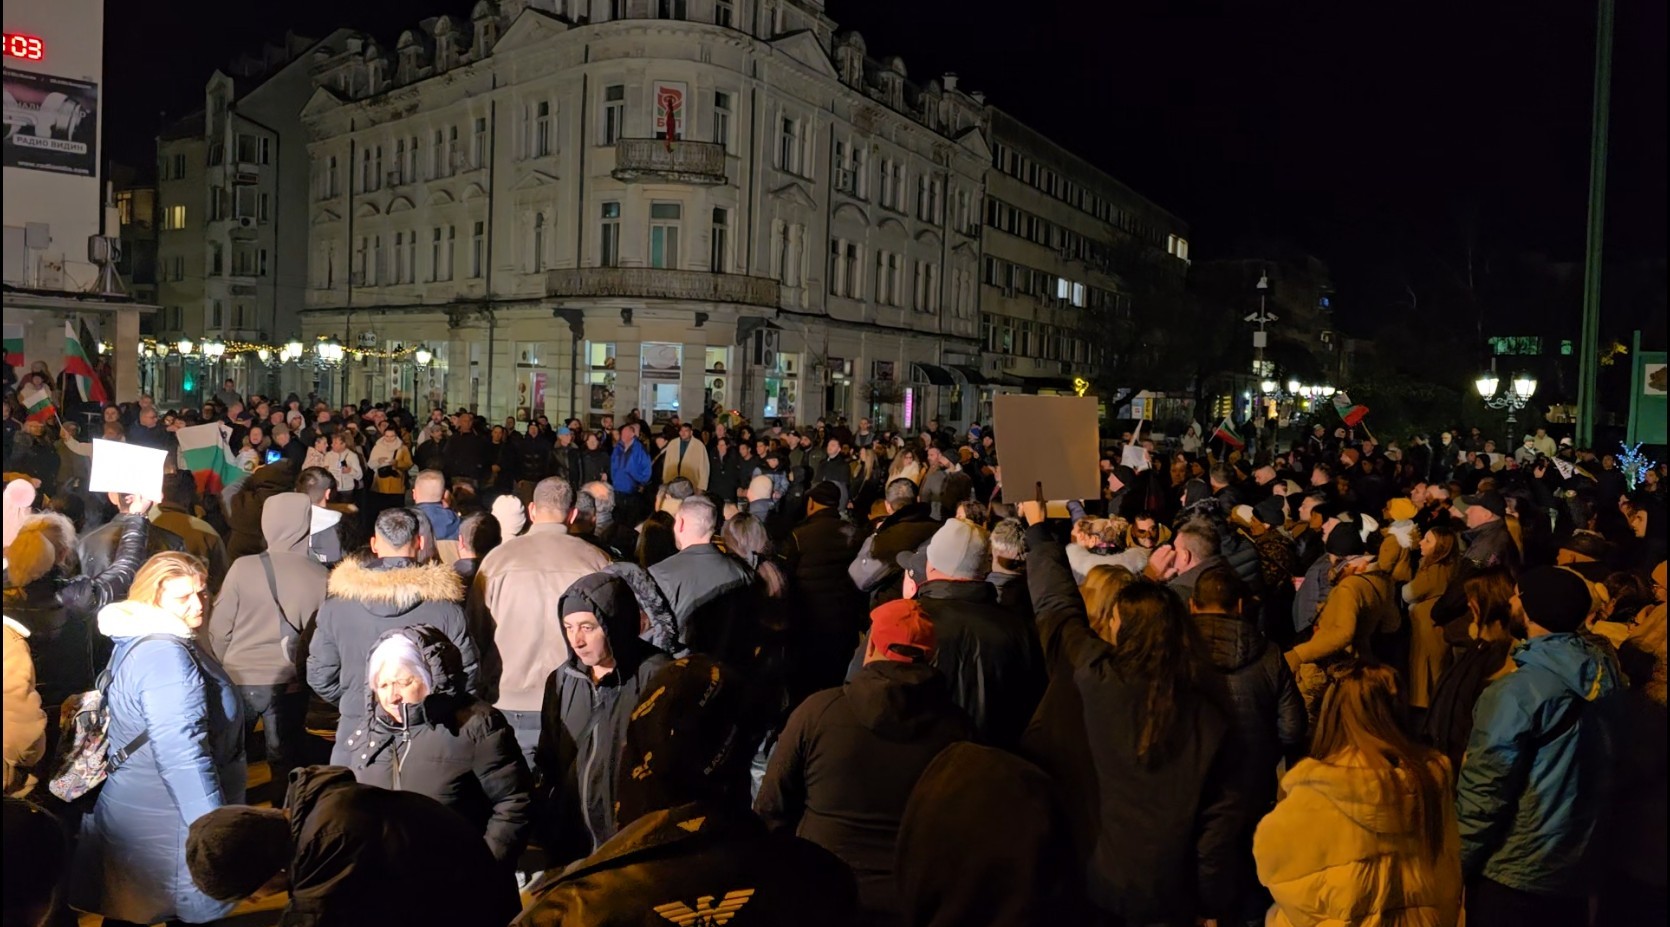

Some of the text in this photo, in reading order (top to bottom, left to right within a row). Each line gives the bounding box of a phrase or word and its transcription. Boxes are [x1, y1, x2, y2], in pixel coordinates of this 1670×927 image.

[3, 35, 42, 60] 03
[657, 118, 682, 128] БП
[17, 136, 83, 152] РАДИО ВИДИН
